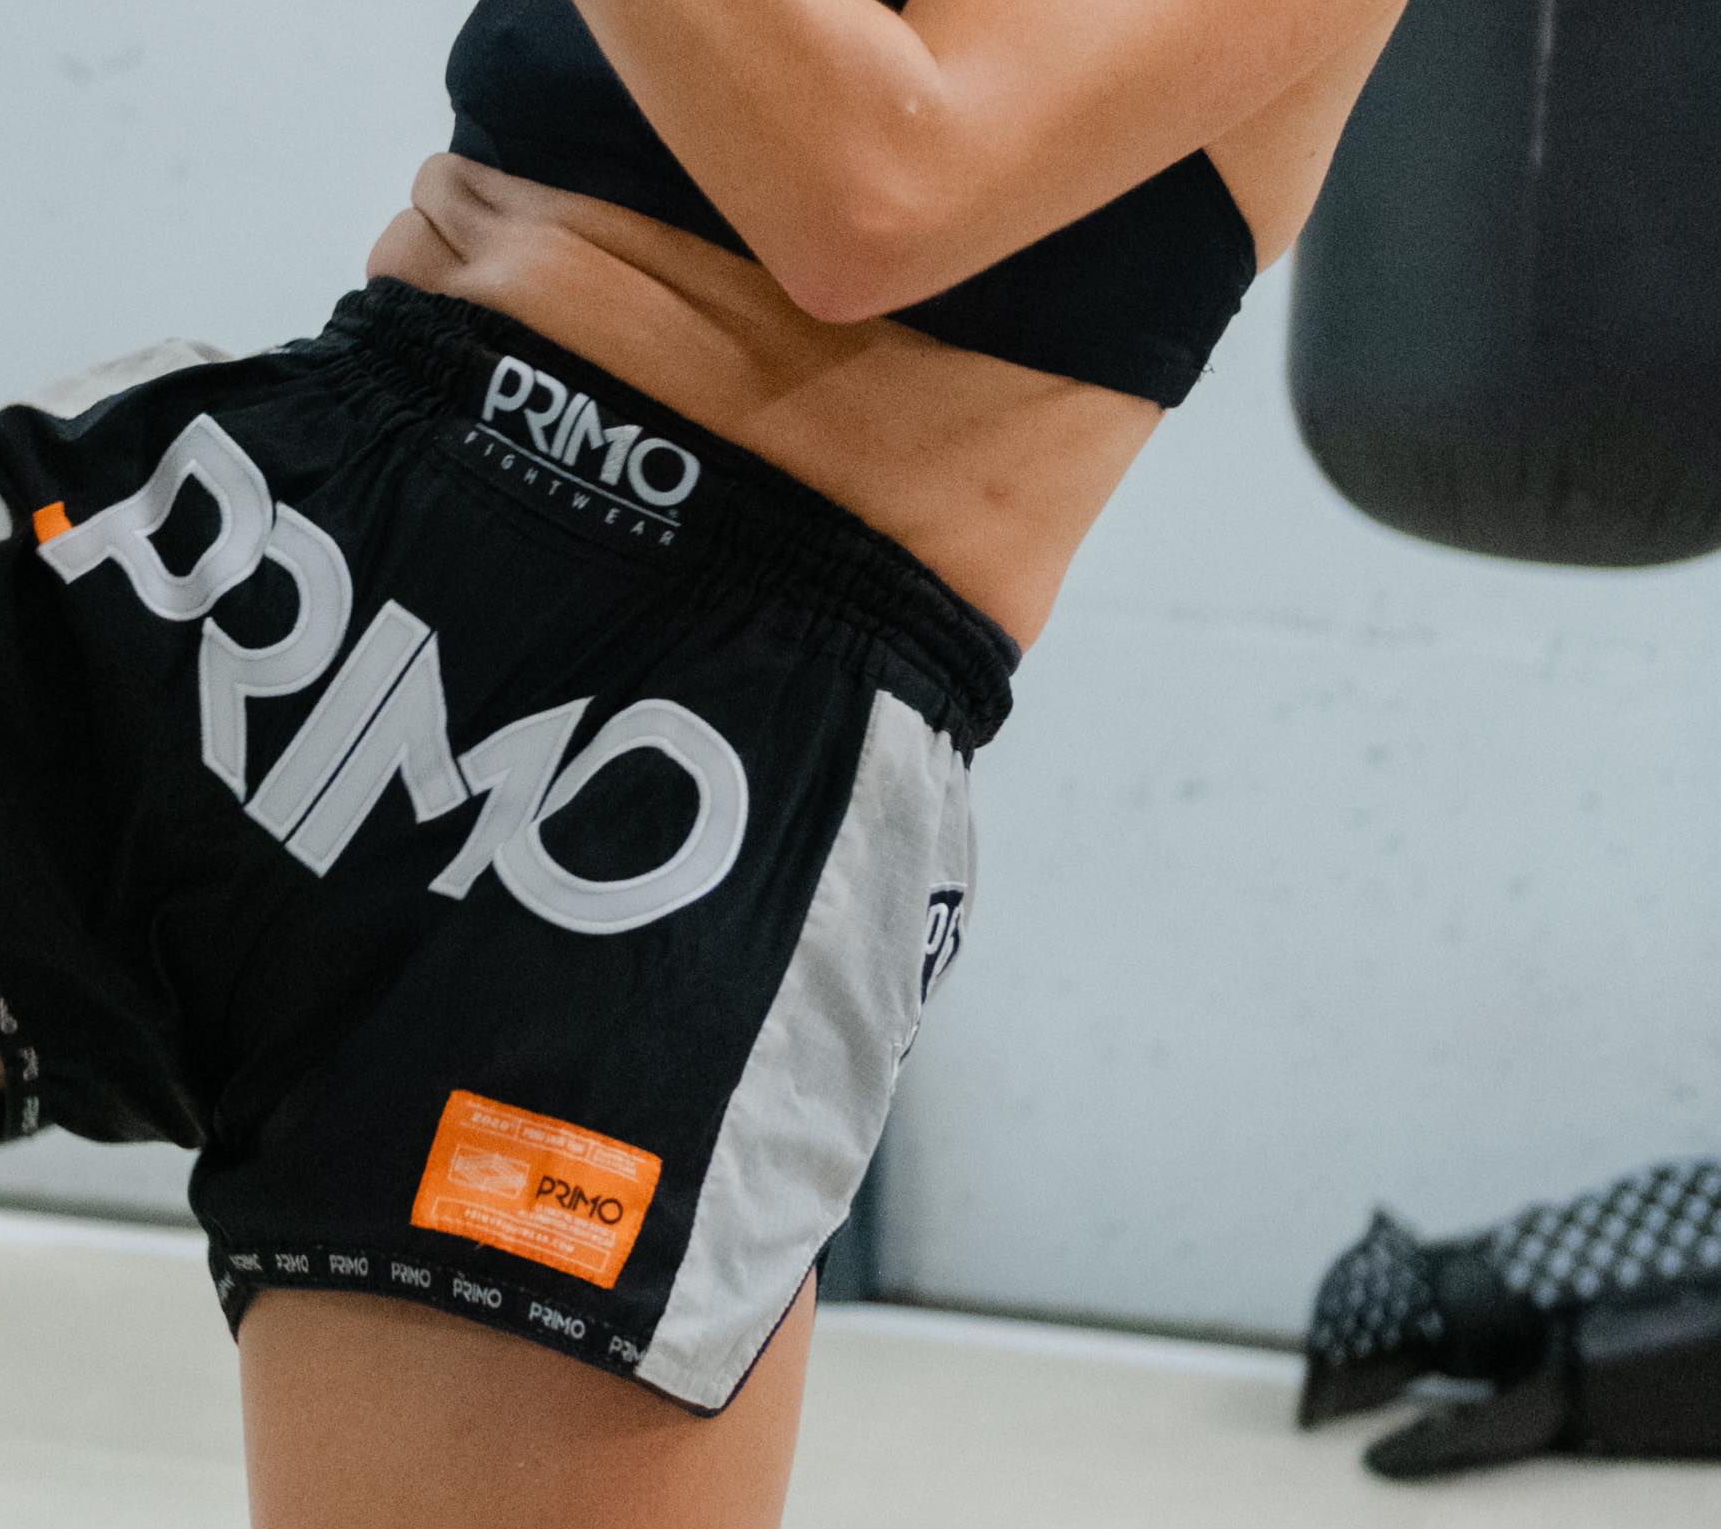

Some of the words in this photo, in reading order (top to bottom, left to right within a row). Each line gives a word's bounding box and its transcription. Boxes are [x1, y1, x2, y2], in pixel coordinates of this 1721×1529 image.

[463, 430, 675, 545] FIGHTWEAR
[482, 354, 701, 506] PRIMO
[36, 411, 749, 935] PRIMO
[535, 1175, 623, 1226] PRIMO
[329, 1254, 368, 1277] PRIMO
[391, 1262, 431, 1289] PRIMO
[453, 1278, 502, 1309] PRIMO
[529, 1302, 585, 1340] PRIMO
